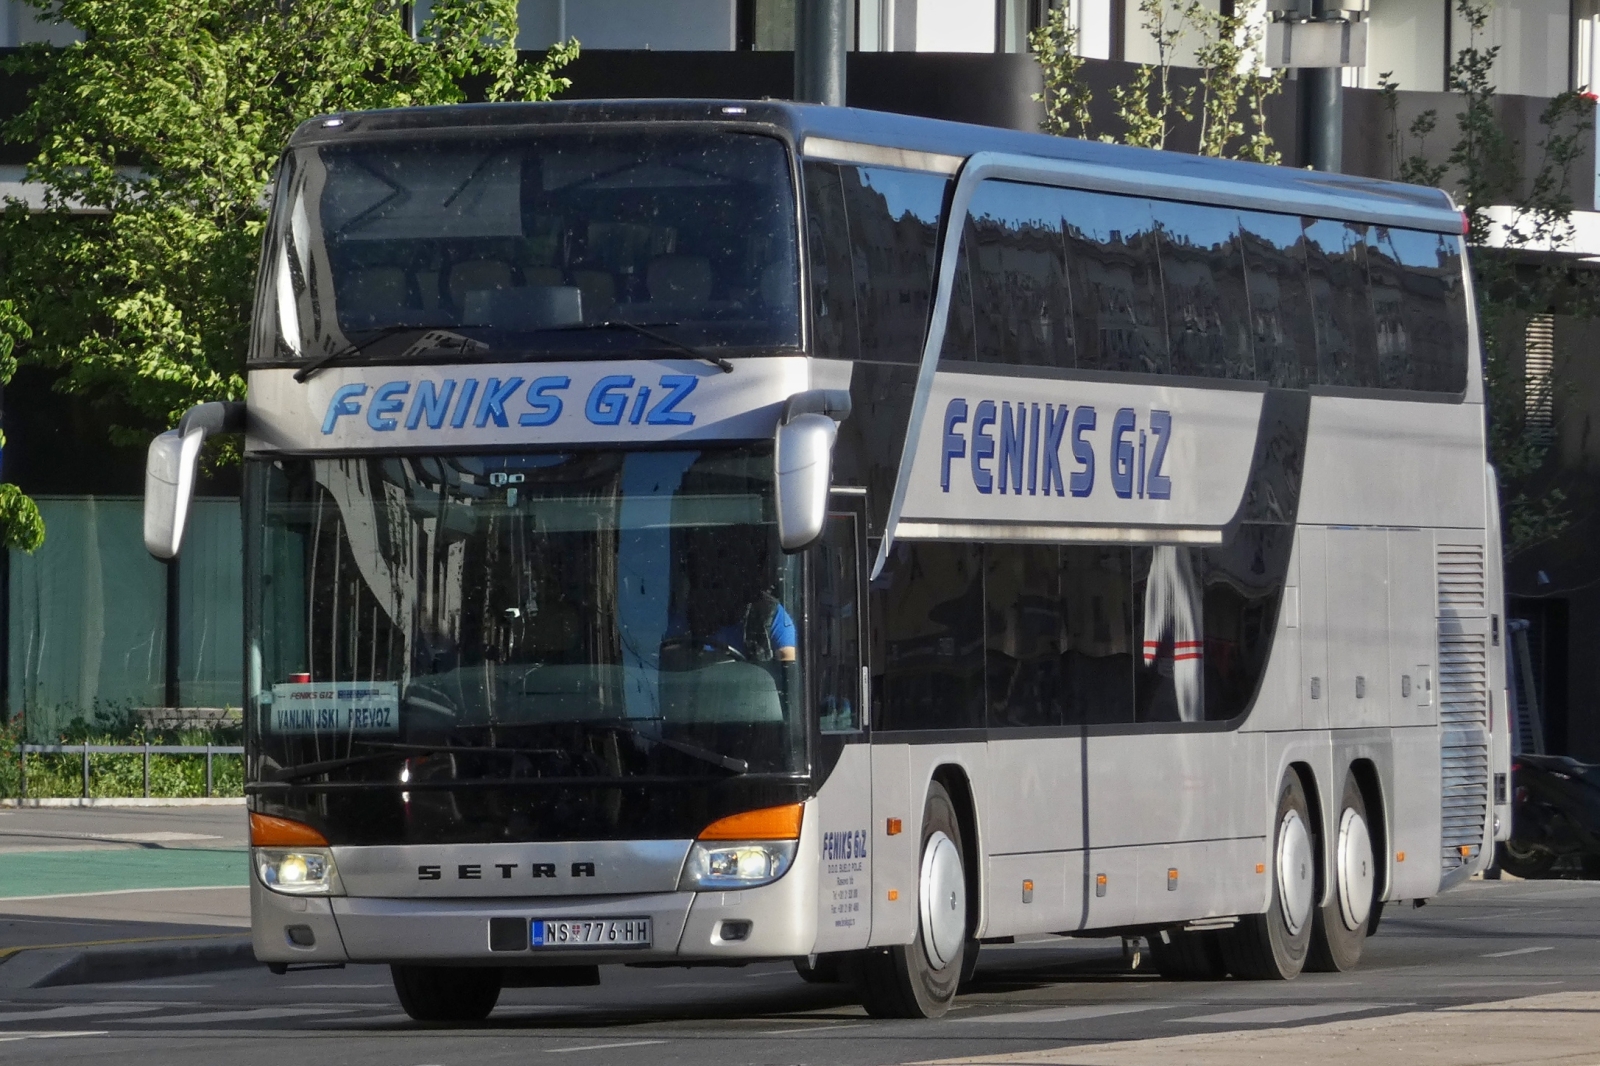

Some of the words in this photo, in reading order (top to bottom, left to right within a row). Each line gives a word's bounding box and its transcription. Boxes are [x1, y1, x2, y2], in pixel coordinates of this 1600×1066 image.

[321, 376, 571, 435] FENIKS
[940, 398, 1097, 498] FENIKS
[289, 691, 318, 700] FENIKS
[277, 708, 339, 731] VANLINIJSKI
[348, 707, 392, 729] PREVOZ
[822, 830, 853, 861] FENIKS
[418, 862, 596, 881] SETRA
[547, 922, 571, 943] NS
